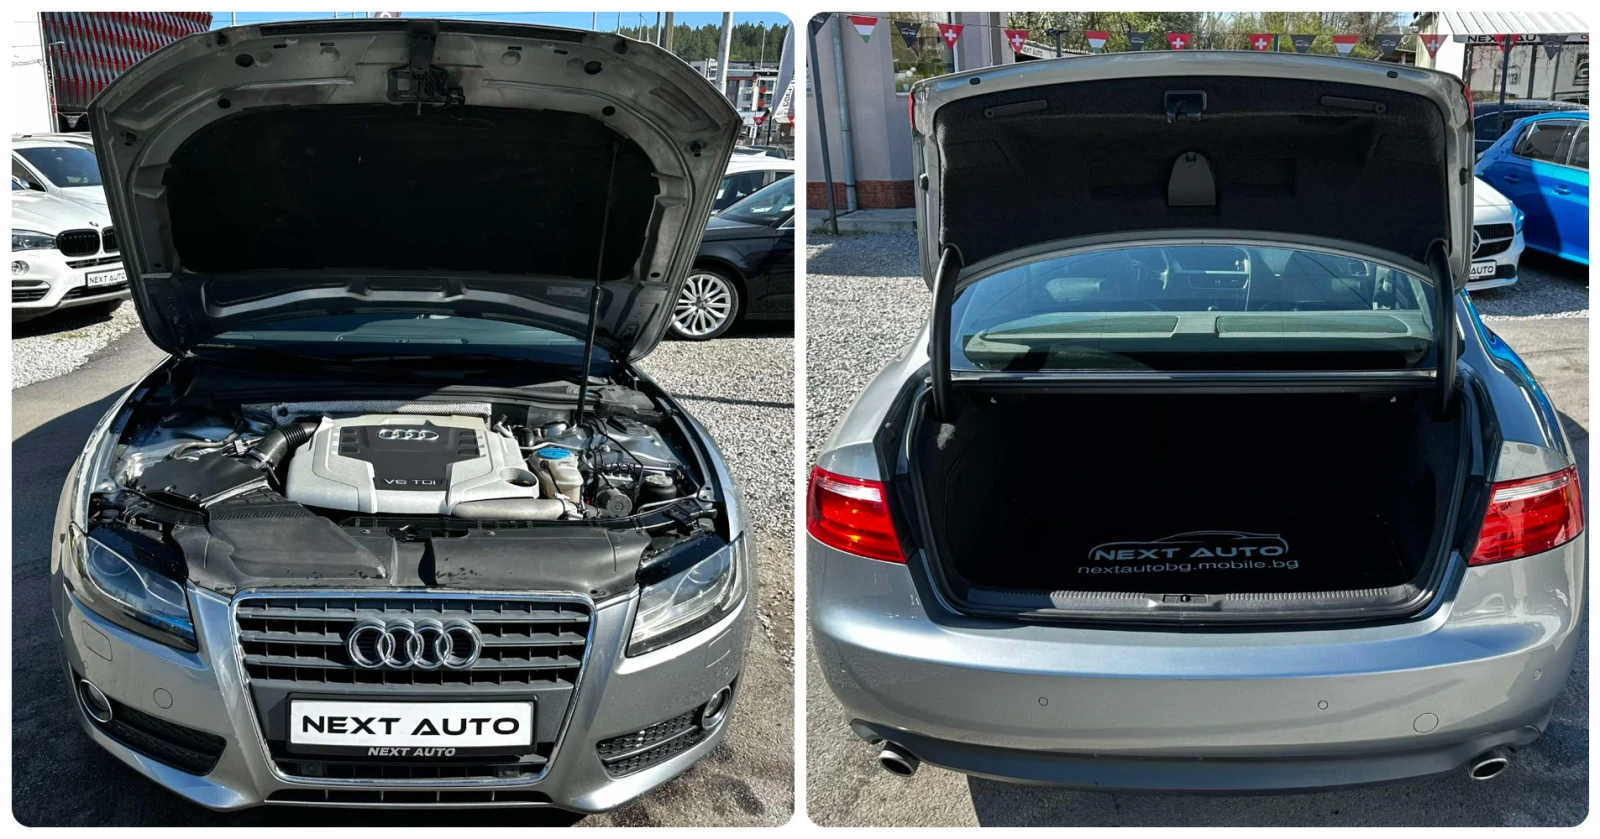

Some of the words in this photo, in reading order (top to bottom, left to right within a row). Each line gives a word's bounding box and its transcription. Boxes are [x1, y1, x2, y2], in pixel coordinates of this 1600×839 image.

[1467, 35, 1497, 43] NEX
[1471, 265, 1494, 275] AUTO
[90, 275, 108, 284] NEXT
[109, 272, 126, 282] AUTO
[1094, 547, 1181, 561] NEXT
[1188, 545, 1284, 559] AUTO
[1077, 558, 1299, 575] nextautobg.mobile.bg
[302, 715, 402, 735] NEXT
[410, 716, 520, 736] AUTO
[367, 746, 411, 757] NEXT
[412, 746, 456, 757] AUTO
